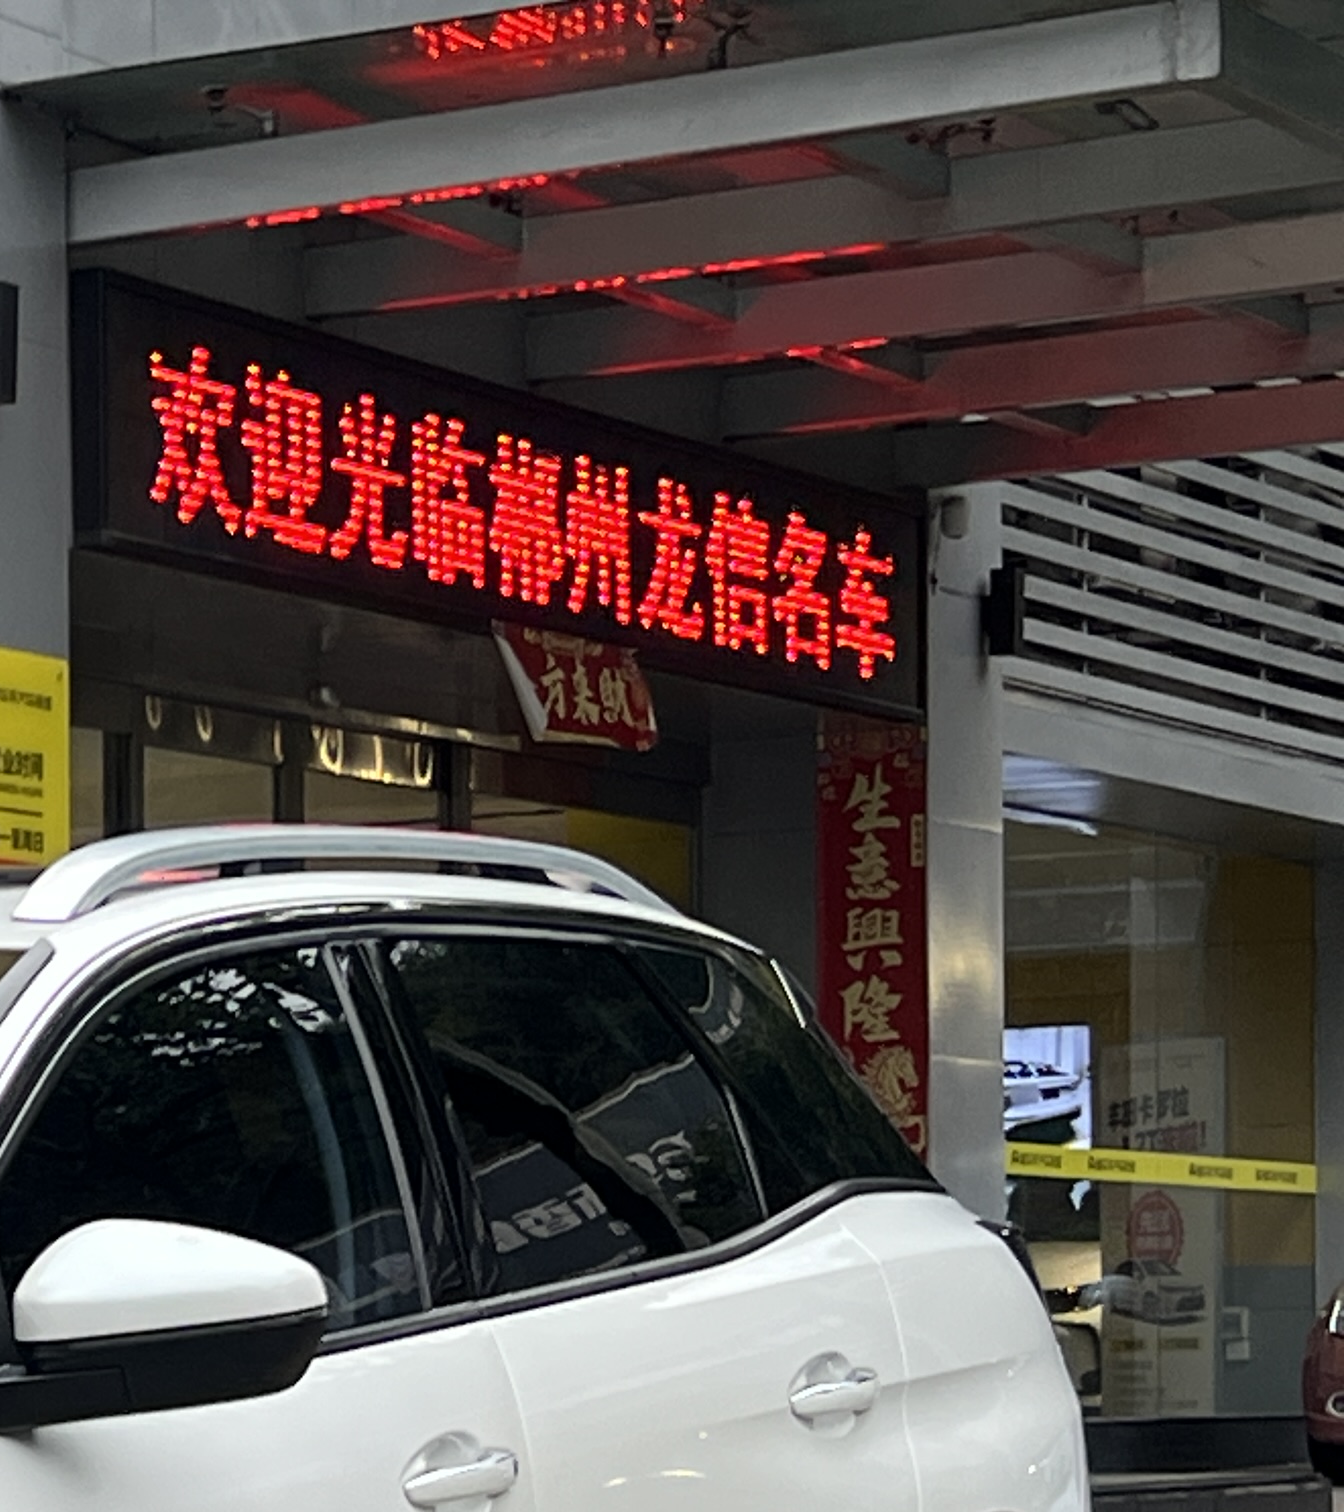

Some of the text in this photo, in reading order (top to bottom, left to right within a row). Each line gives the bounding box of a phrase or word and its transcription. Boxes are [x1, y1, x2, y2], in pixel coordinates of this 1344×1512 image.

[149, 346, 896, 680] 欢迎光临郴州龙信名车
